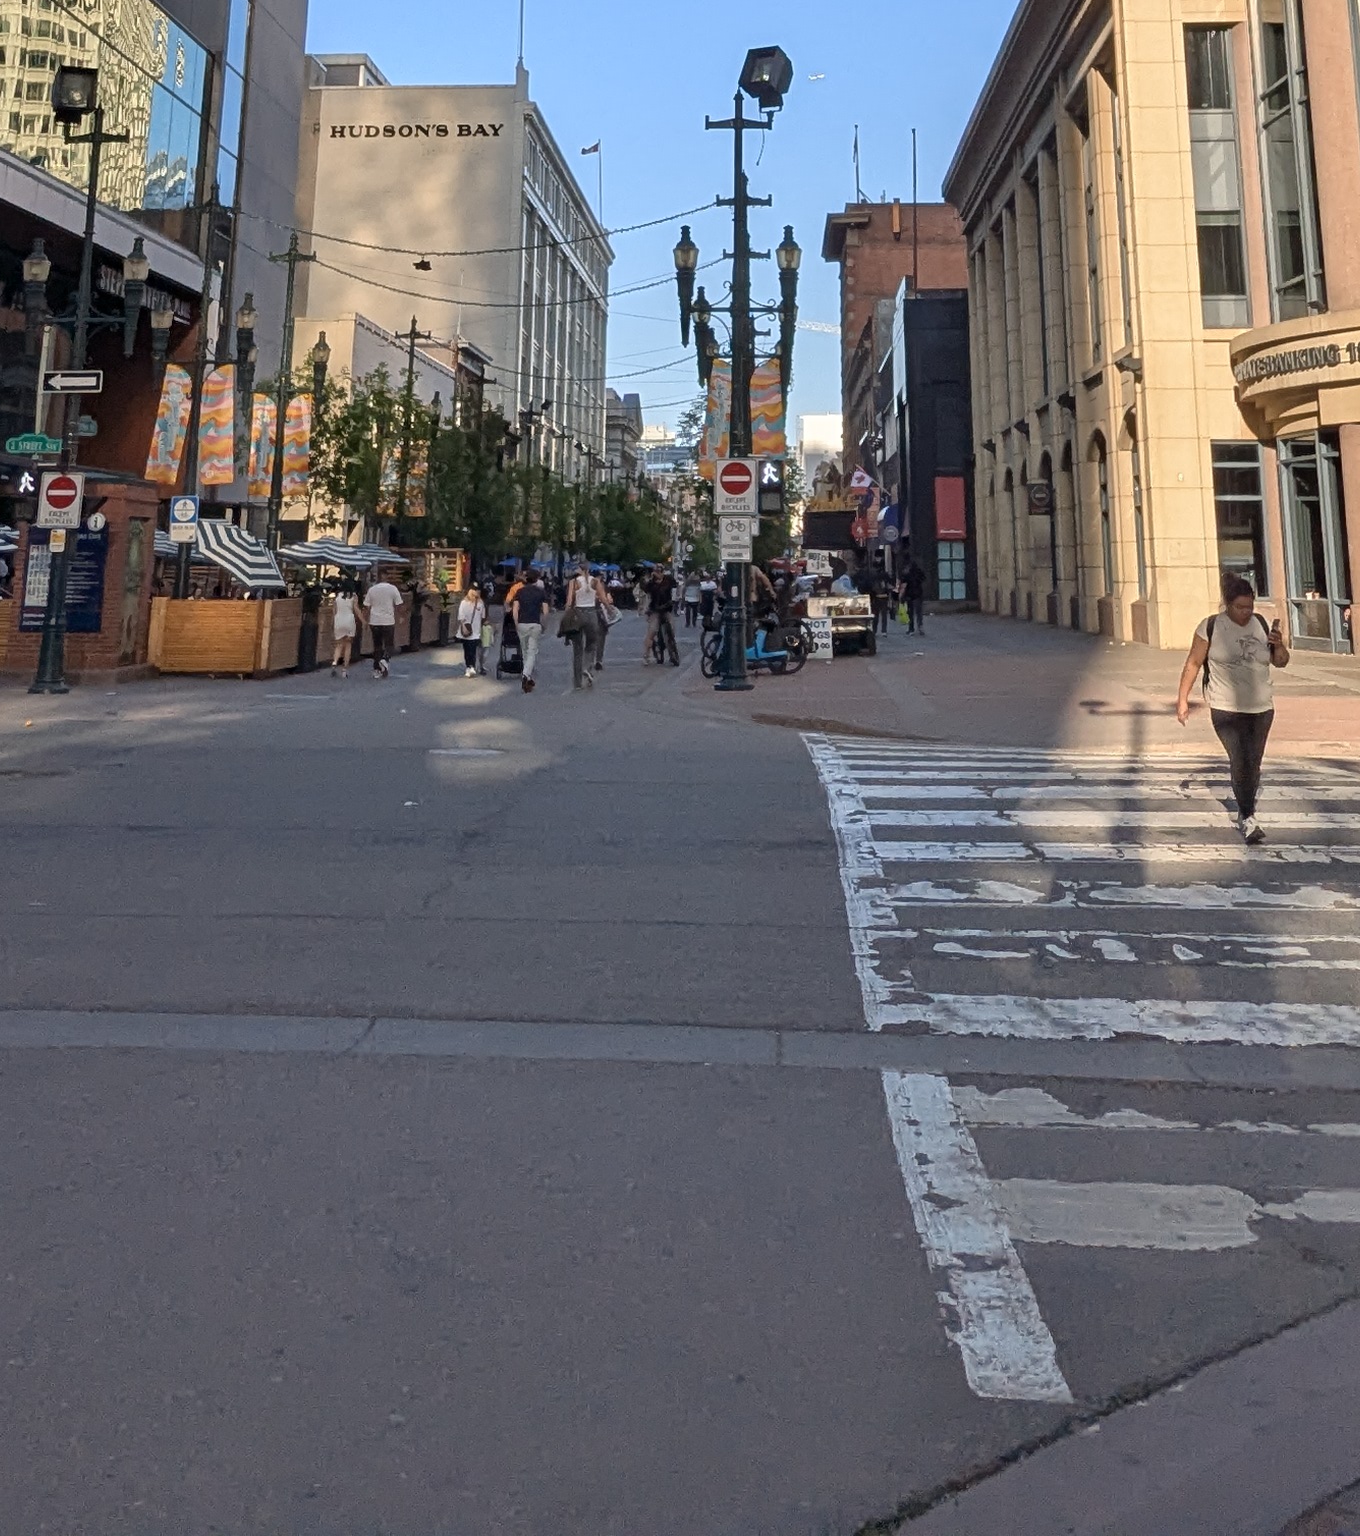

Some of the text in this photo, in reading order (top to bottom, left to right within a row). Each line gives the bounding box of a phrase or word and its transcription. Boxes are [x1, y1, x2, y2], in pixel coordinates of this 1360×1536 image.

[330, 123, 504, 138] HUDSON'S BAY
[1266, 344, 1341, 374] BANKING
